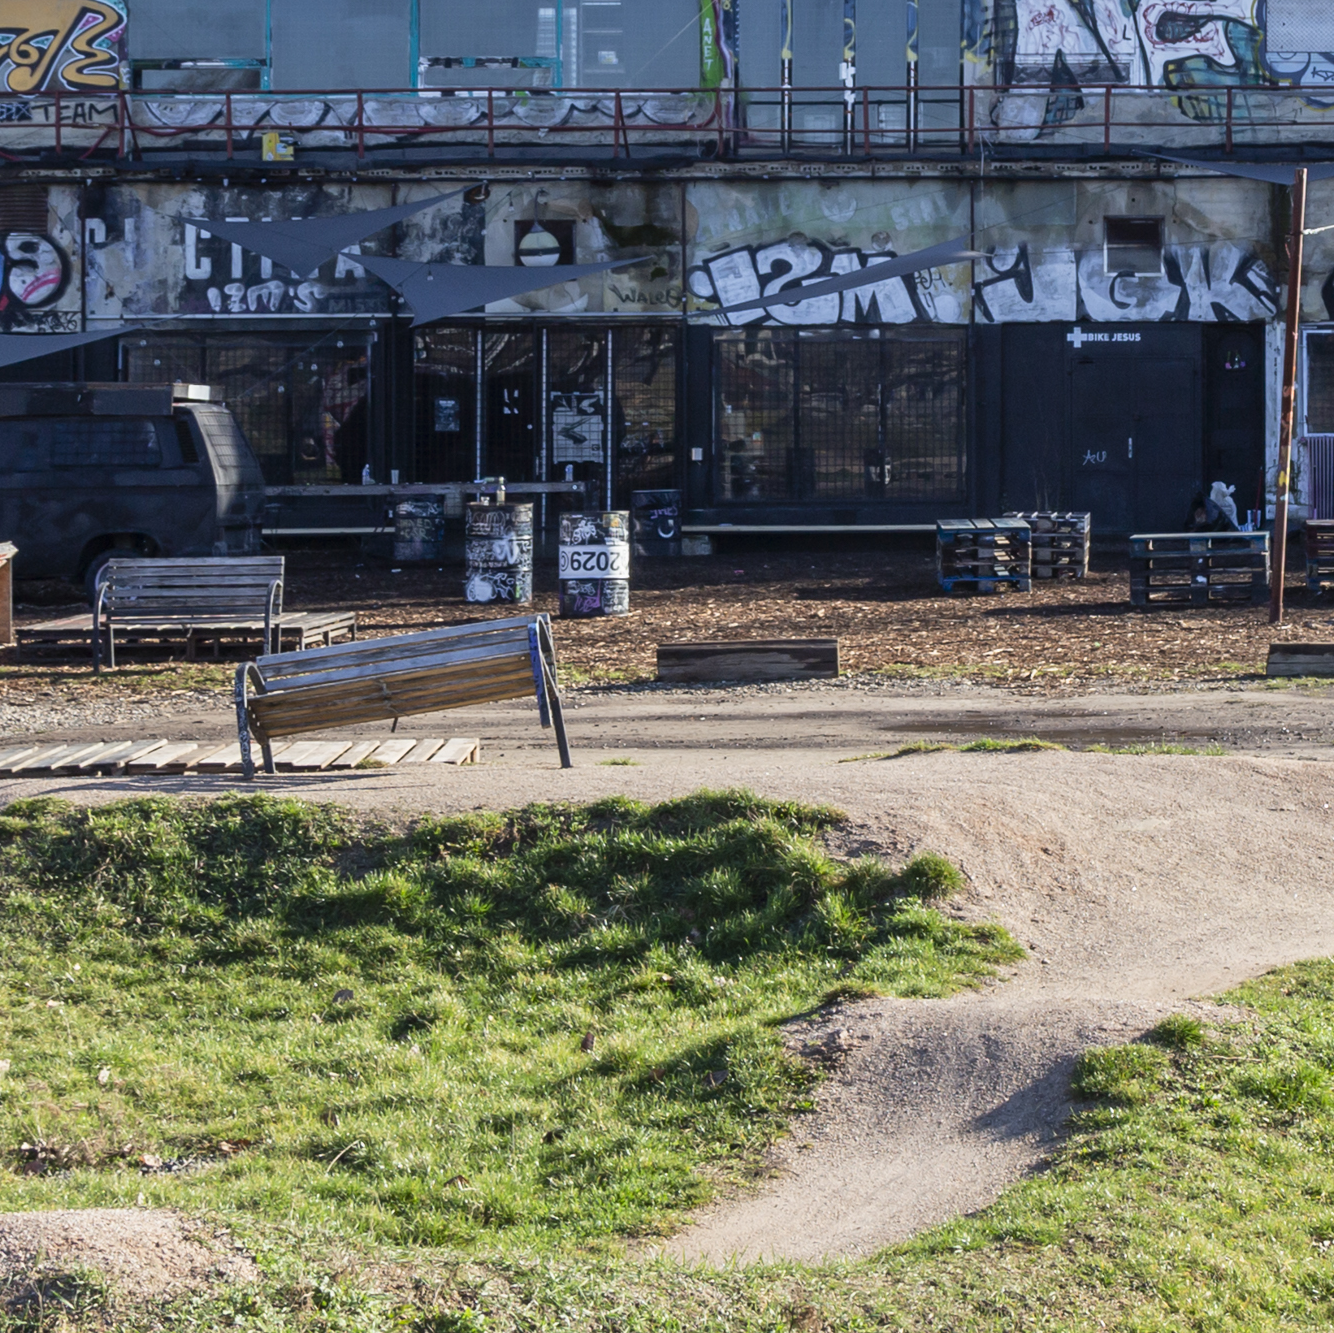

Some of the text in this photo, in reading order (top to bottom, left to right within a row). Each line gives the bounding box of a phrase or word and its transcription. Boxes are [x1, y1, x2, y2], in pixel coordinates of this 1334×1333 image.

[31, 102, 118, 124] TEAM
[1087, 332, 1142, 342] BIKE JESUS
